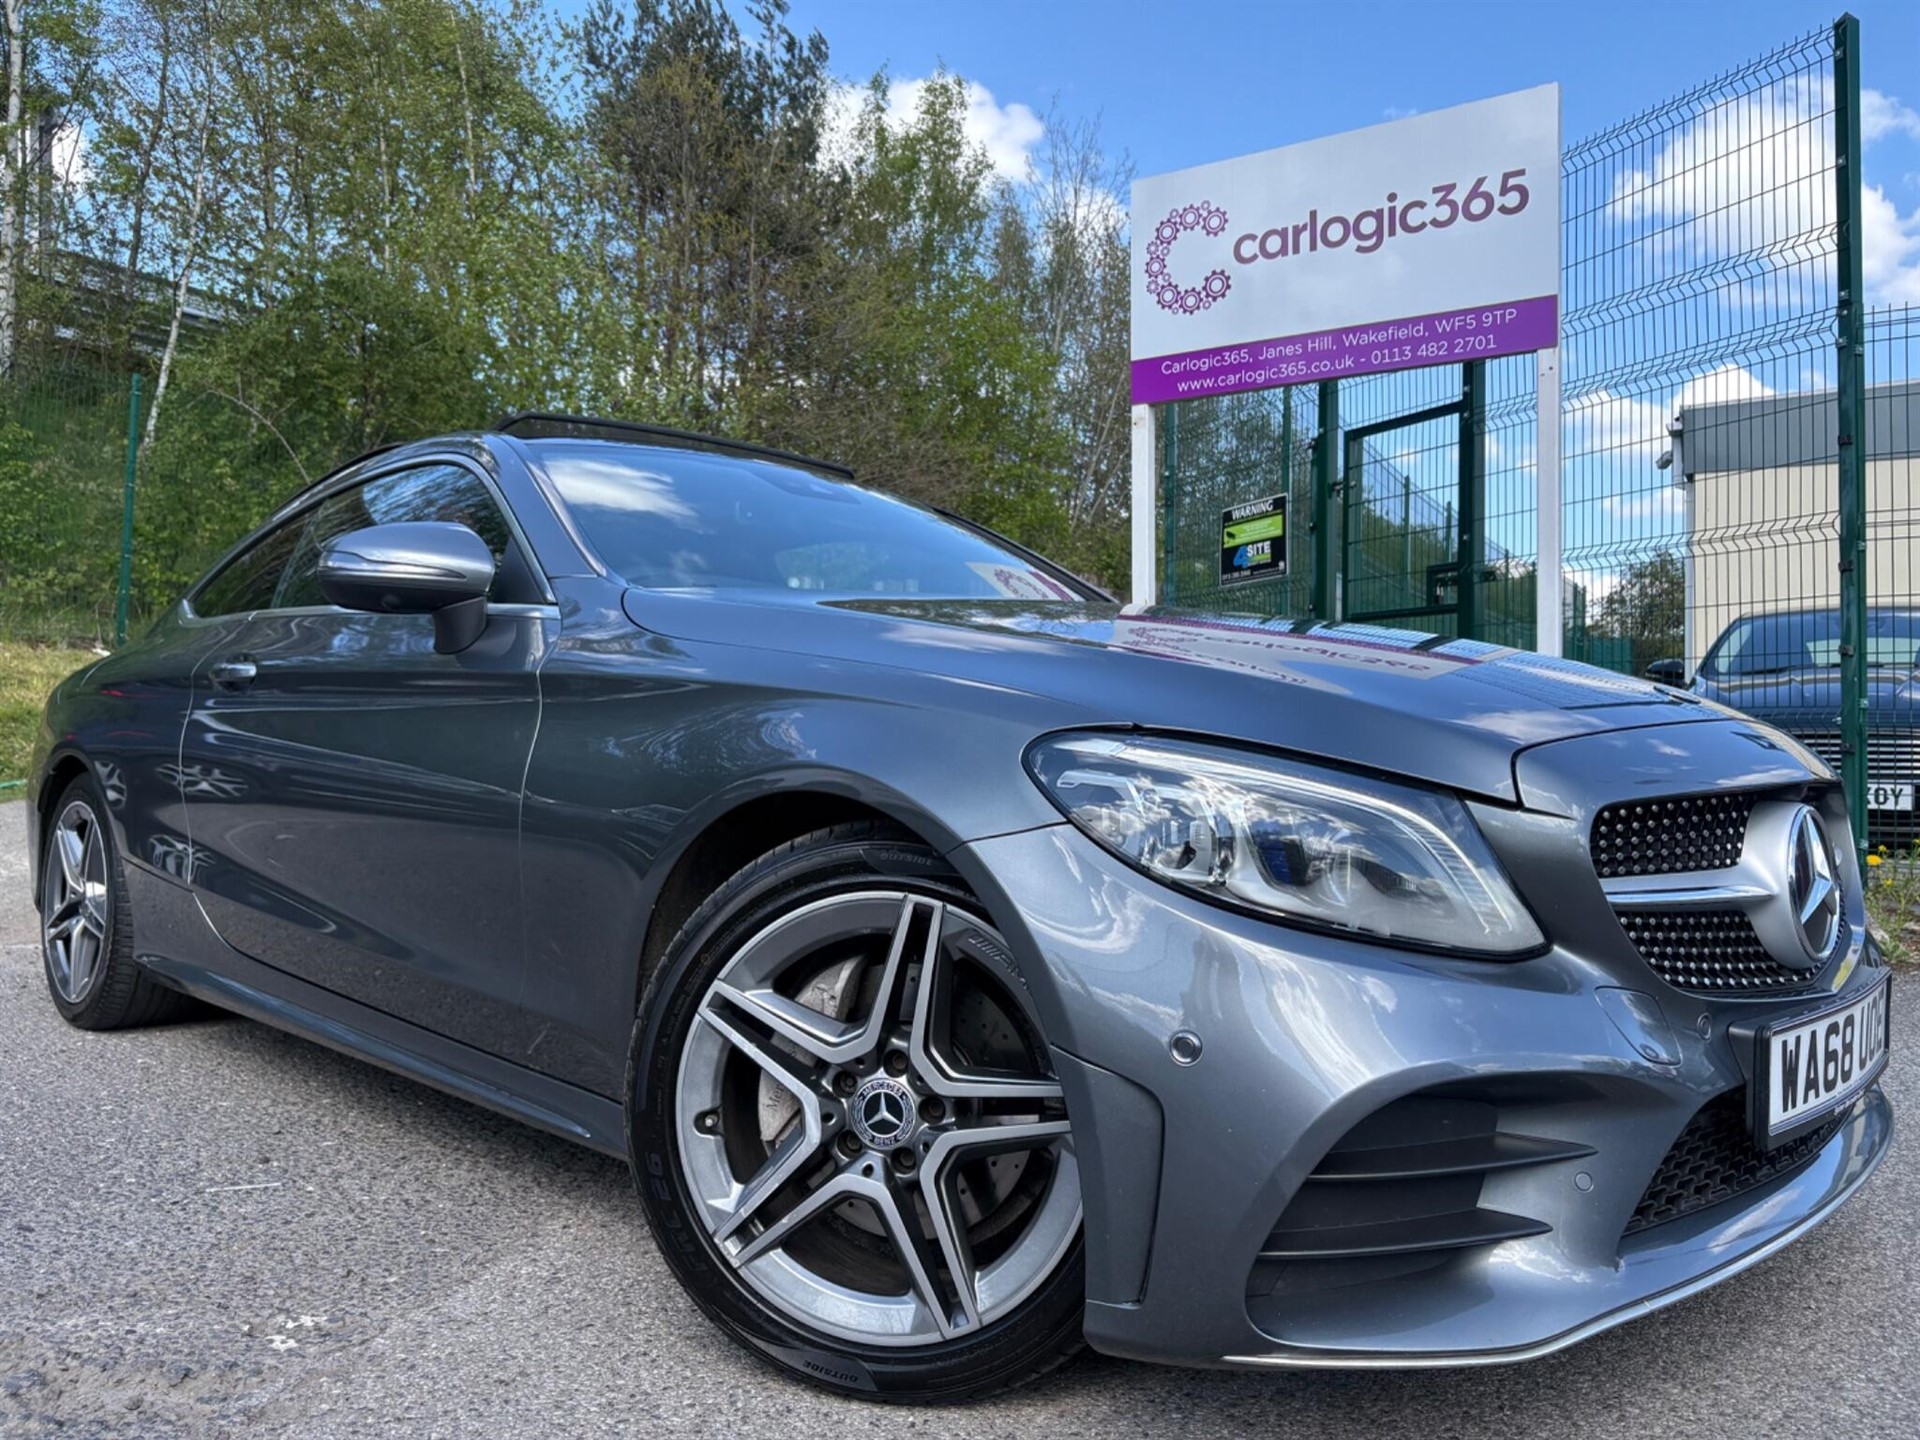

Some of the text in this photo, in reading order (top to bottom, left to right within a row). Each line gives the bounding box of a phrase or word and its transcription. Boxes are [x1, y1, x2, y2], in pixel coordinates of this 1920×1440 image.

[1233, 168, 1530, 265] carlogic365
[1161, 308, 1518, 375] Carlogic365, Janes Hill, Wakefield, WF5 9TP
[1177, 354, 1355, 393] www.carlogic365.co.uk
[1371, 346, 1412, 365] 0113
[1417, 340, 1449, 358] 482
[1454, 334, 1497, 354] 2701
[1231, 499, 1274, 521] WARNING
[1868, 786, 1904, 808] OY
[879, 851, 934, 867] OUTSIDE
[1781, 1013, 1855, 1114] WA68
[801, 1359, 859, 1383] OUTSIDE
